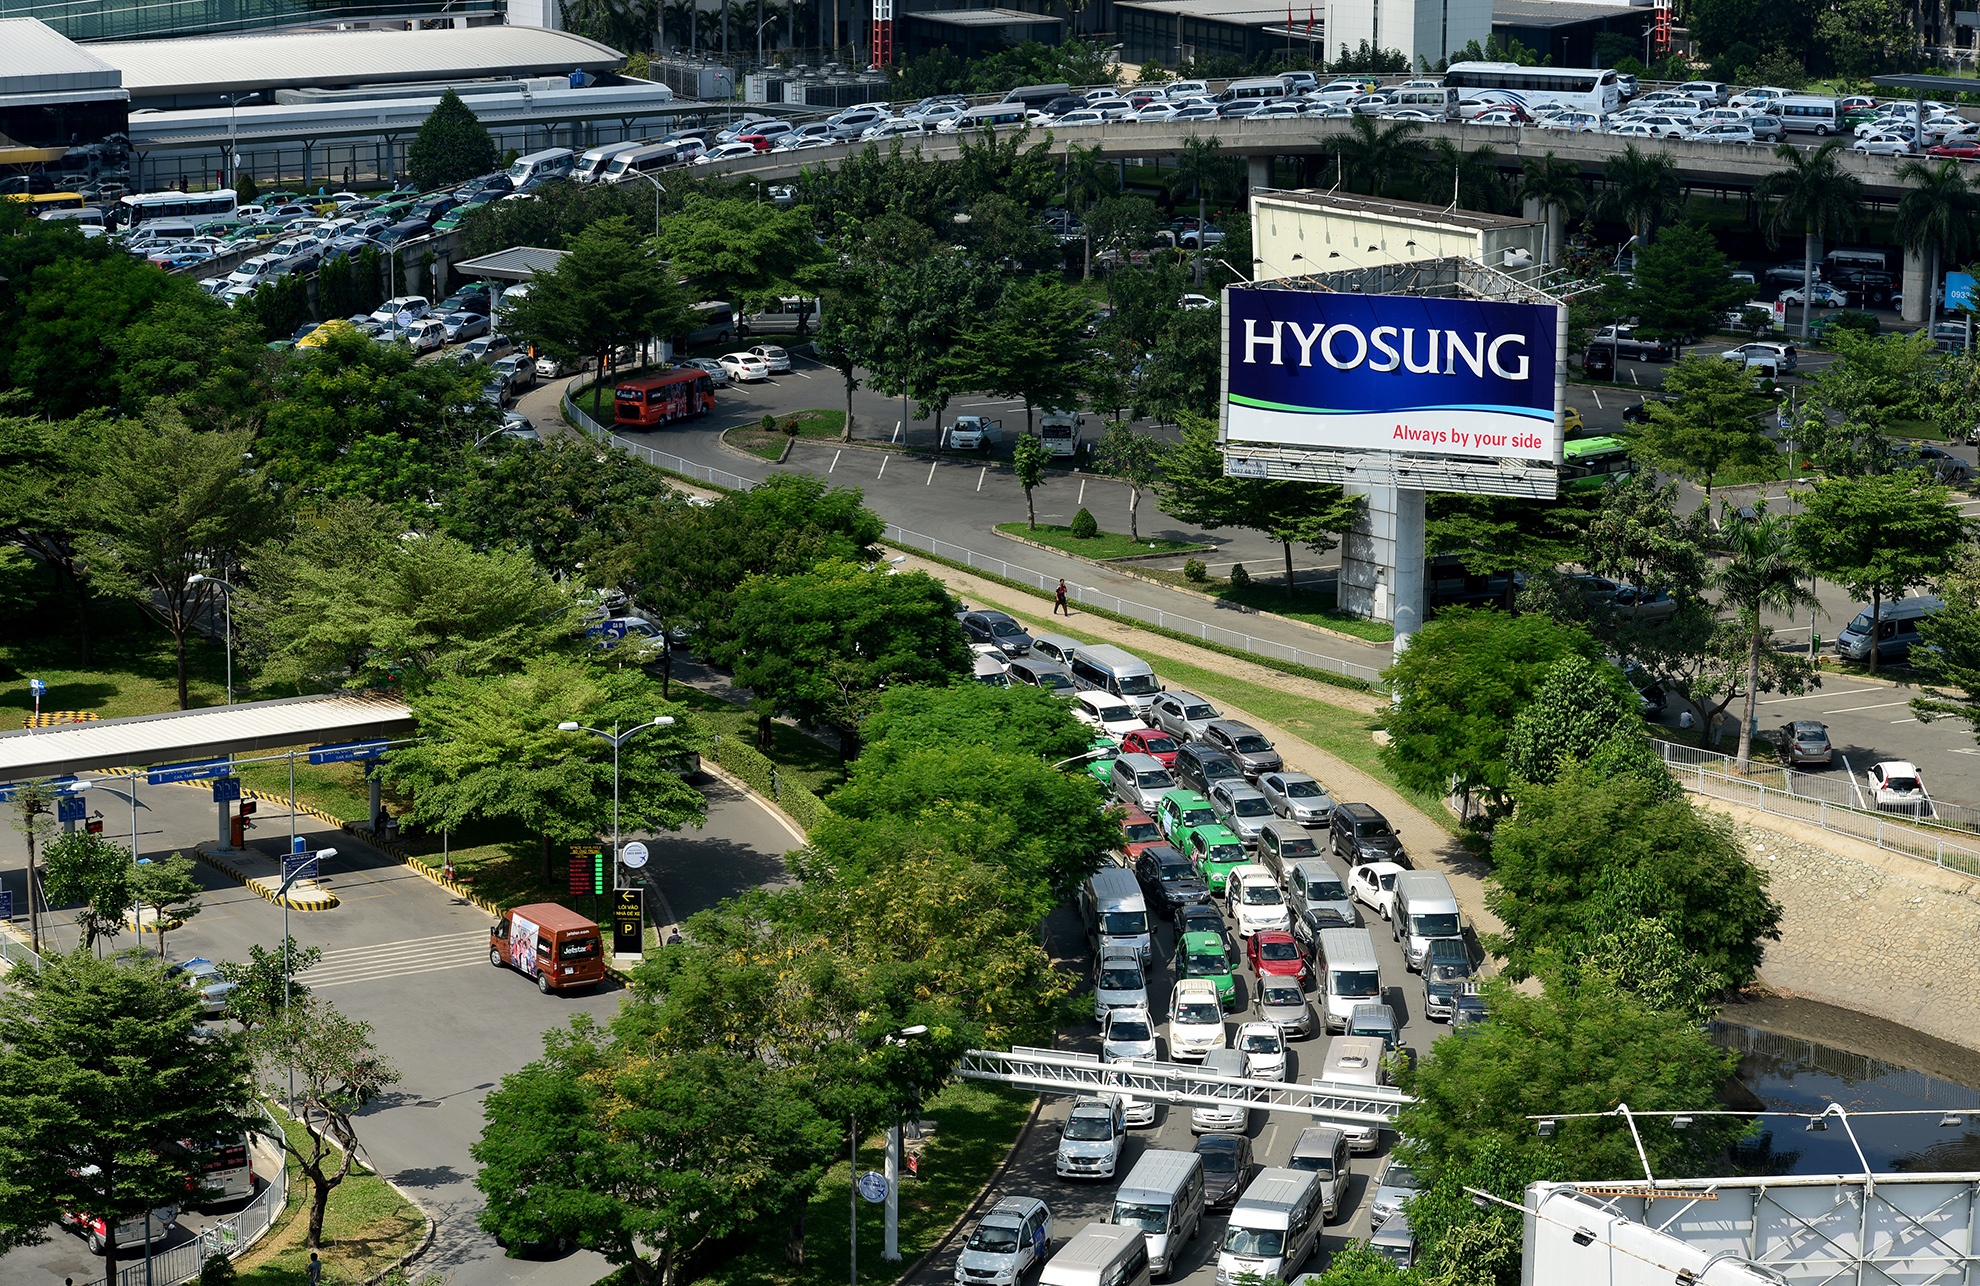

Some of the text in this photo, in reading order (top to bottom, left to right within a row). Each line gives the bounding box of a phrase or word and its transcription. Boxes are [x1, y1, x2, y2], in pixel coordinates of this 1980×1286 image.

[1243, 319, 1530, 380] HYOSUNG
[1393, 424, 1542, 449] Always by your side
[563, 944, 587, 955] Jetstar
